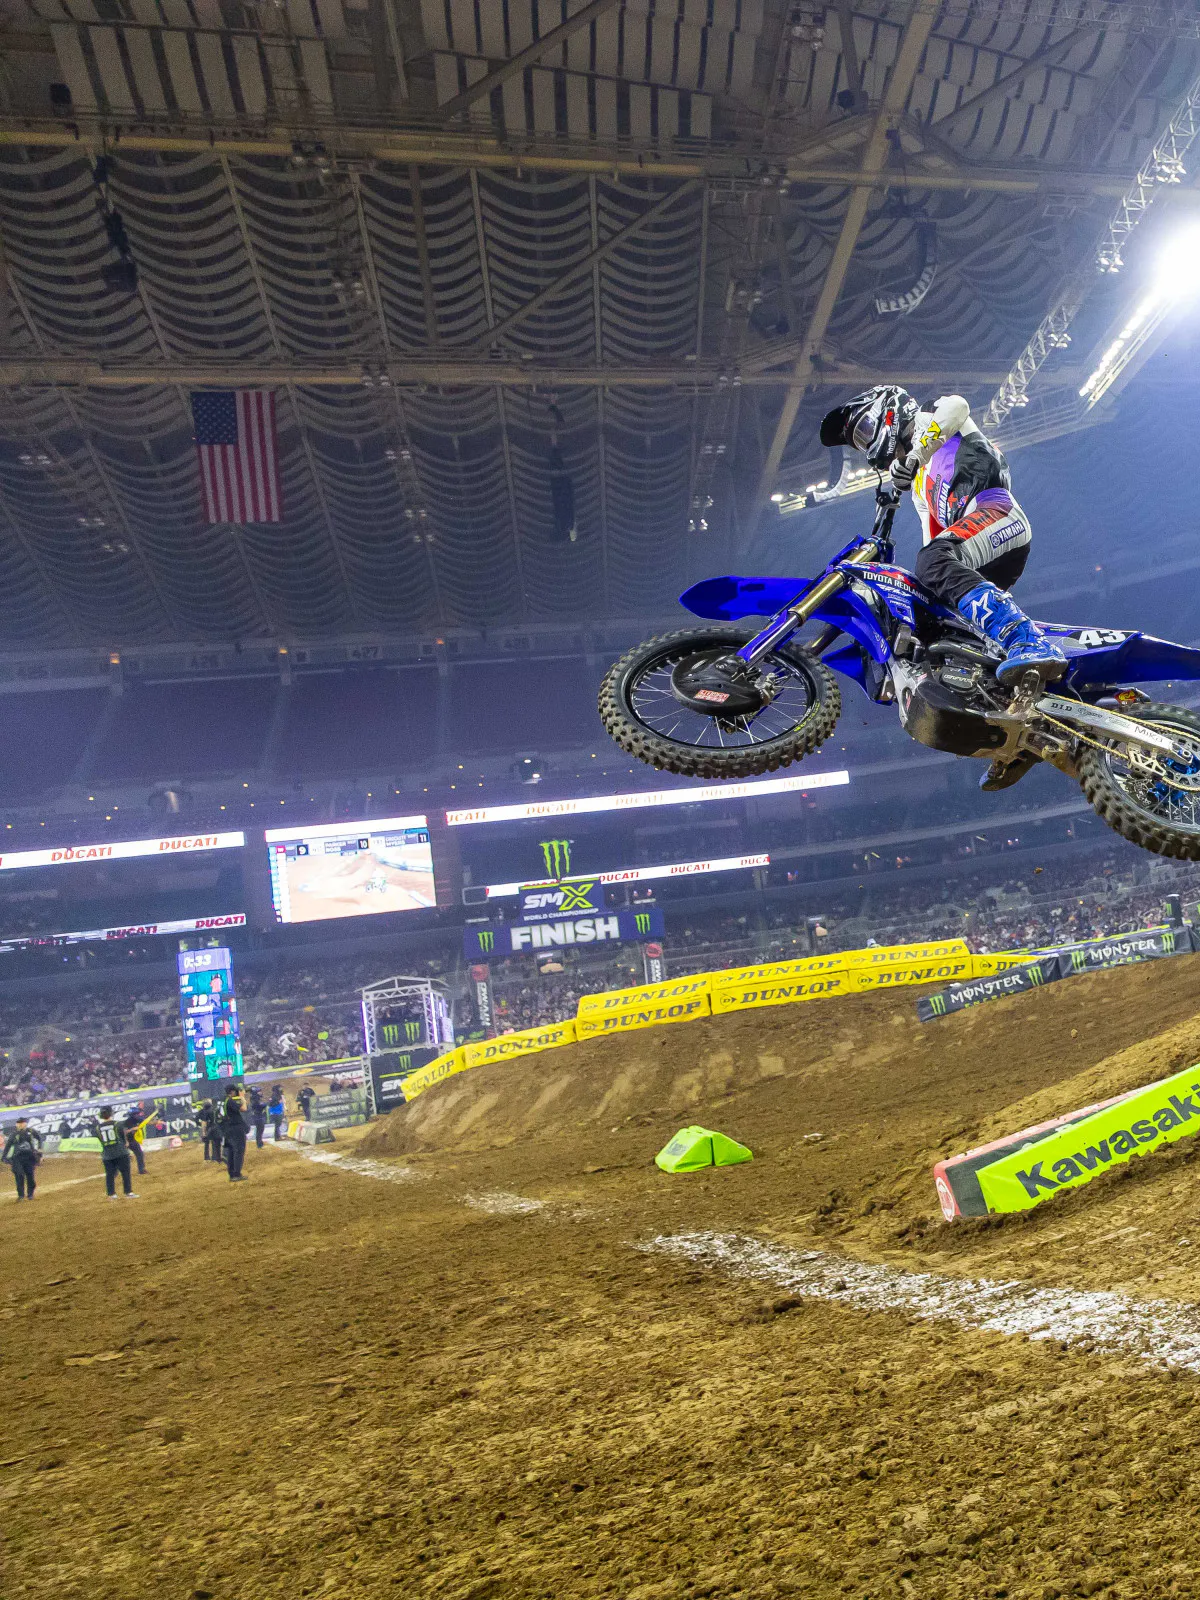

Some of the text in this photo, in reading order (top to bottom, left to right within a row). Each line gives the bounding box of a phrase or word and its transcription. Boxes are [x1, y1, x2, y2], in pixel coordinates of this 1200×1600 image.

[939, 482, 951, 519] YAMAHA
[997, 521, 1026, 543] YAMAHA
[862, 570, 893, 585] TOYOTA
[894, 580, 930, 605] REDLANDS
[1078, 630, 1126, 646] 43
[701, 785, 748, 797] DUCATI
[615, 794, 664, 806] DUCATI
[526, 803, 577, 815] DUCATI
[159, 837, 218, 851] DUCATI
[299, 845, 306, 855] 9
[359, 840, 367, 849] 10
[51, 847, 113, 862] DUCATI
[670, 862, 711, 874] DUCATI
[523, 883, 594, 911] SMX
[195, 915, 245, 929] DUCATI
[523, 907, 599, 922] WORLD CHAMPIONSHIP
[106, 925, 158, 940] DUCATI
[511, 917, 620, 950] FINISH
[870, 945, 963, 963] DUNLOP
[737, 959, 842, 981] DUNLOP
[876, 964, 965, 984] DUNLOP
[604, 979, 706, 1009] DUNLOP
[740, 979, 841, 1004] DUNLOP
[603, 1000, 702, 1030] DUNLOP
[484, 1030, 564, 1059] DUNLOP
